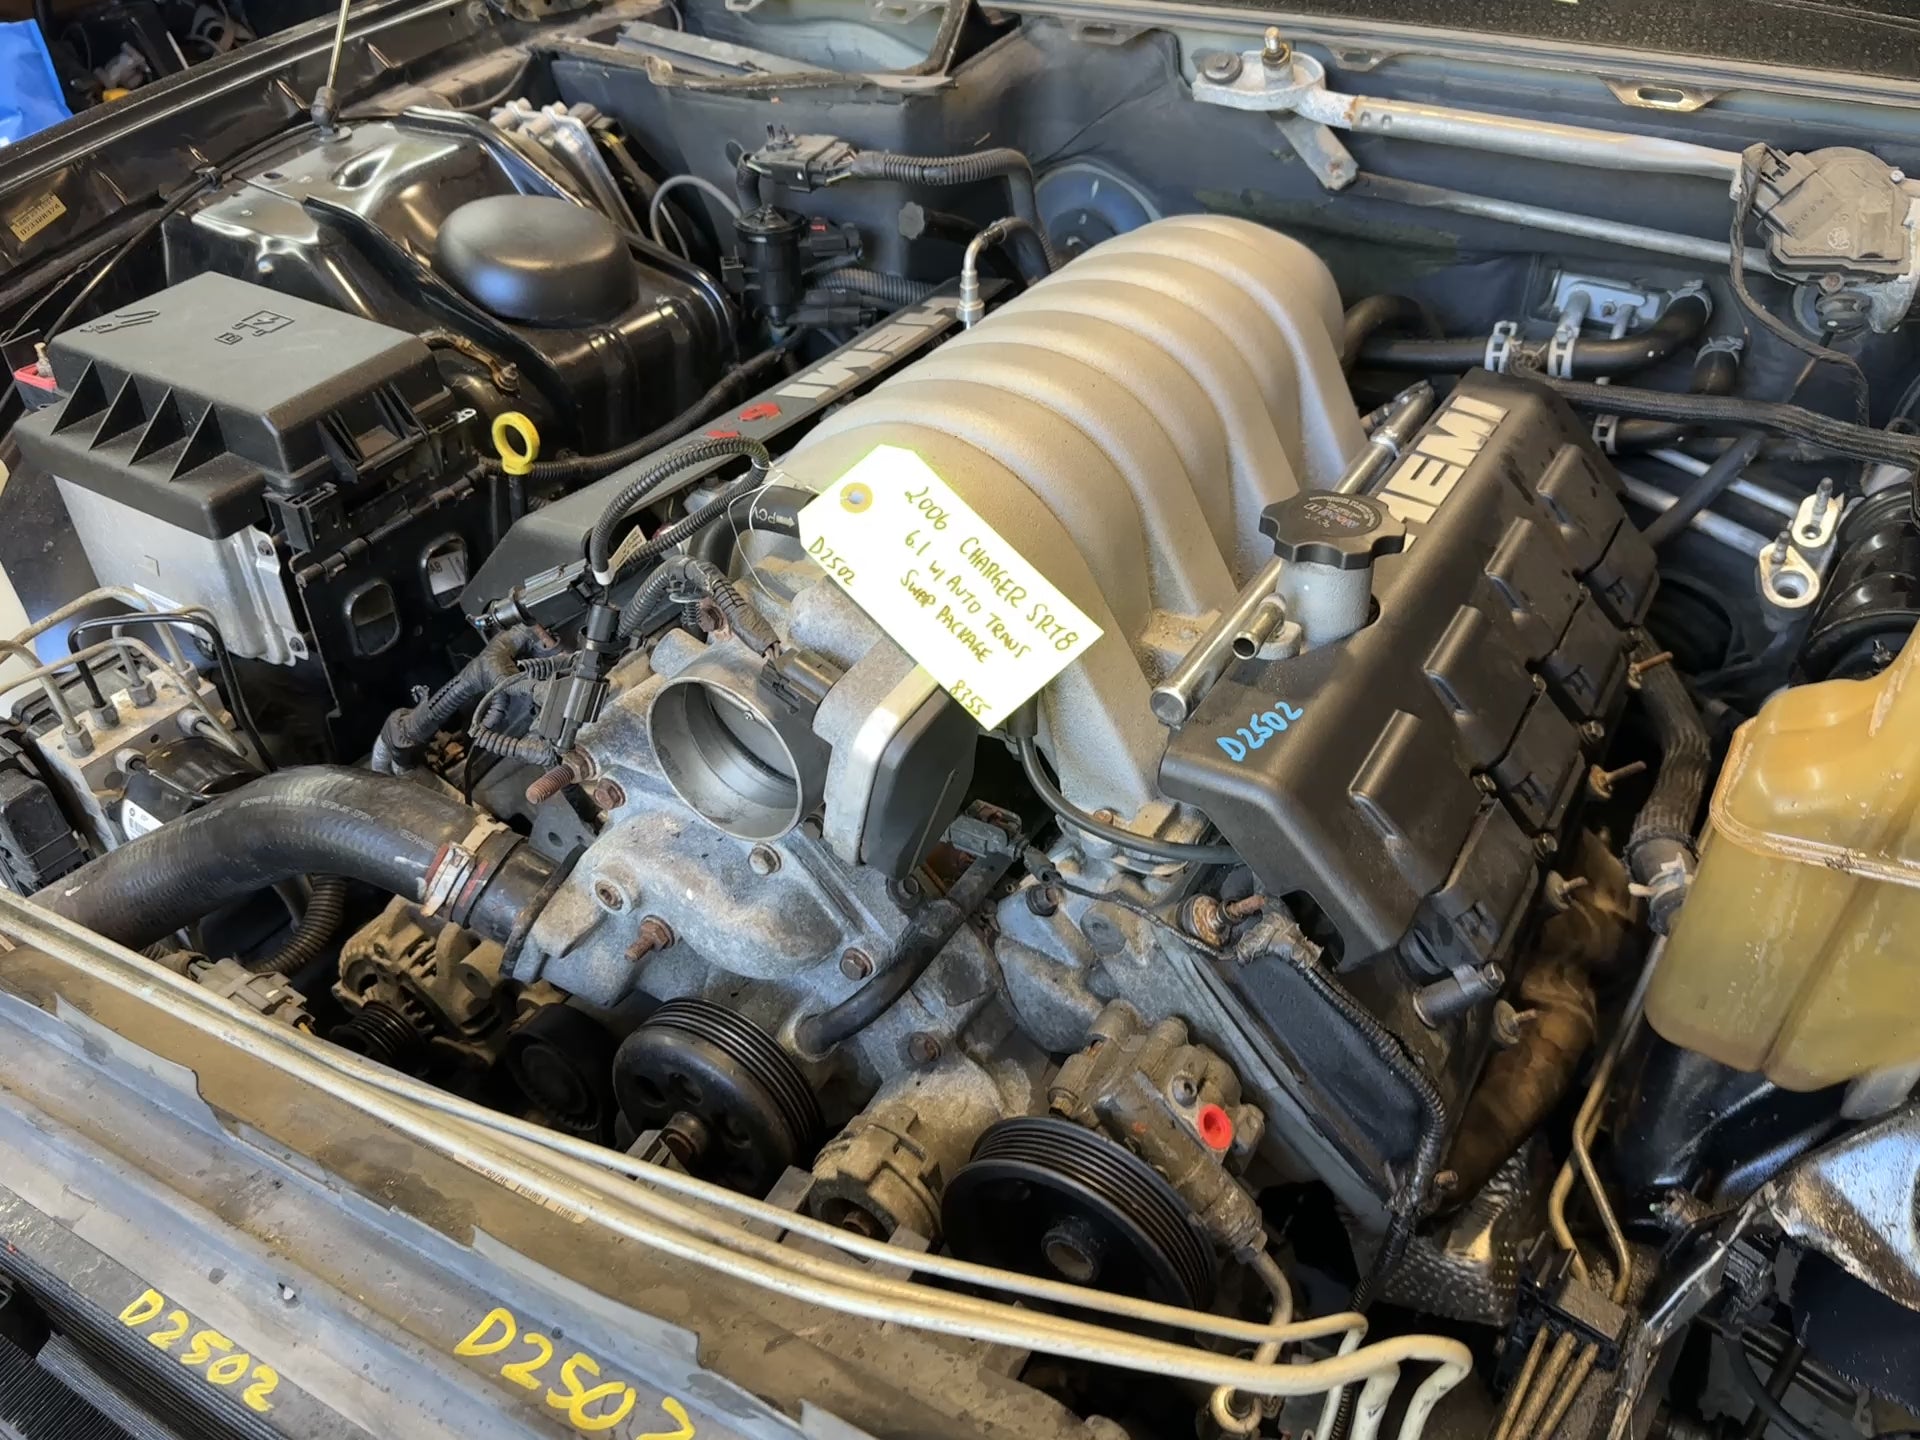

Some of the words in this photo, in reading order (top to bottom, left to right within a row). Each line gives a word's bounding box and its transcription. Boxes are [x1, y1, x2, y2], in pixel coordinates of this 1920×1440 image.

[776, 296, 962, 400] HEMI
[808, 536, 855, 586] D2502
[904, 486, 947, 530] 2006
[959, 537, 1026, 608] CHARGER
[1026, 604, 1079, 651] SRT8
[904, 530, 931, 556] 6.1
[985, 612, 1031, 658] TRANS
[936, 605, 993, 663] PACKAGE
[949, 680, 992, 716] 8355
[1216, 701, 1304, 762] D2502
[118, 1288, 278, 1412] D2502
